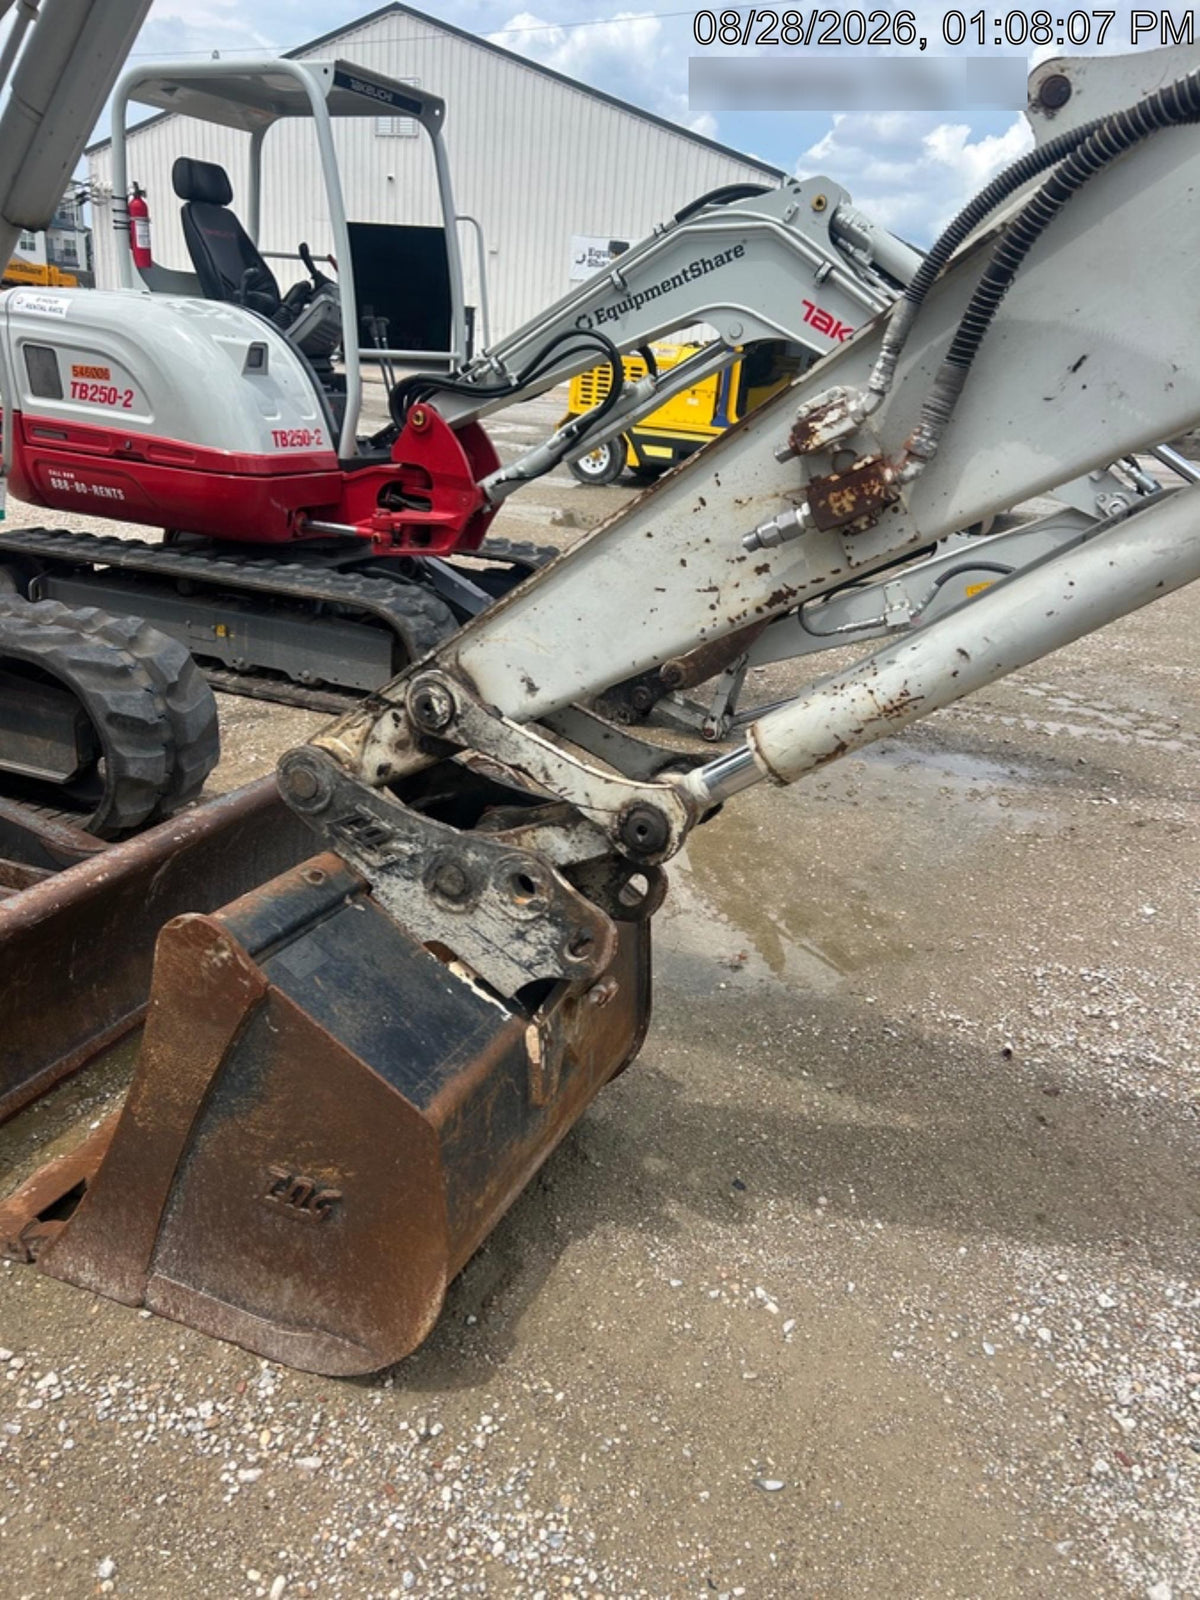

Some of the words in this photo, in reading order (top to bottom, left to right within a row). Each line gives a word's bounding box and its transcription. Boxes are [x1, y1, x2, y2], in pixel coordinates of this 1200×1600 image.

[593, 243, 746, 326] EquipmentShare
[70, 382, 133, 408] TB250-2
[271, 428, 323, 448] TB250-2
